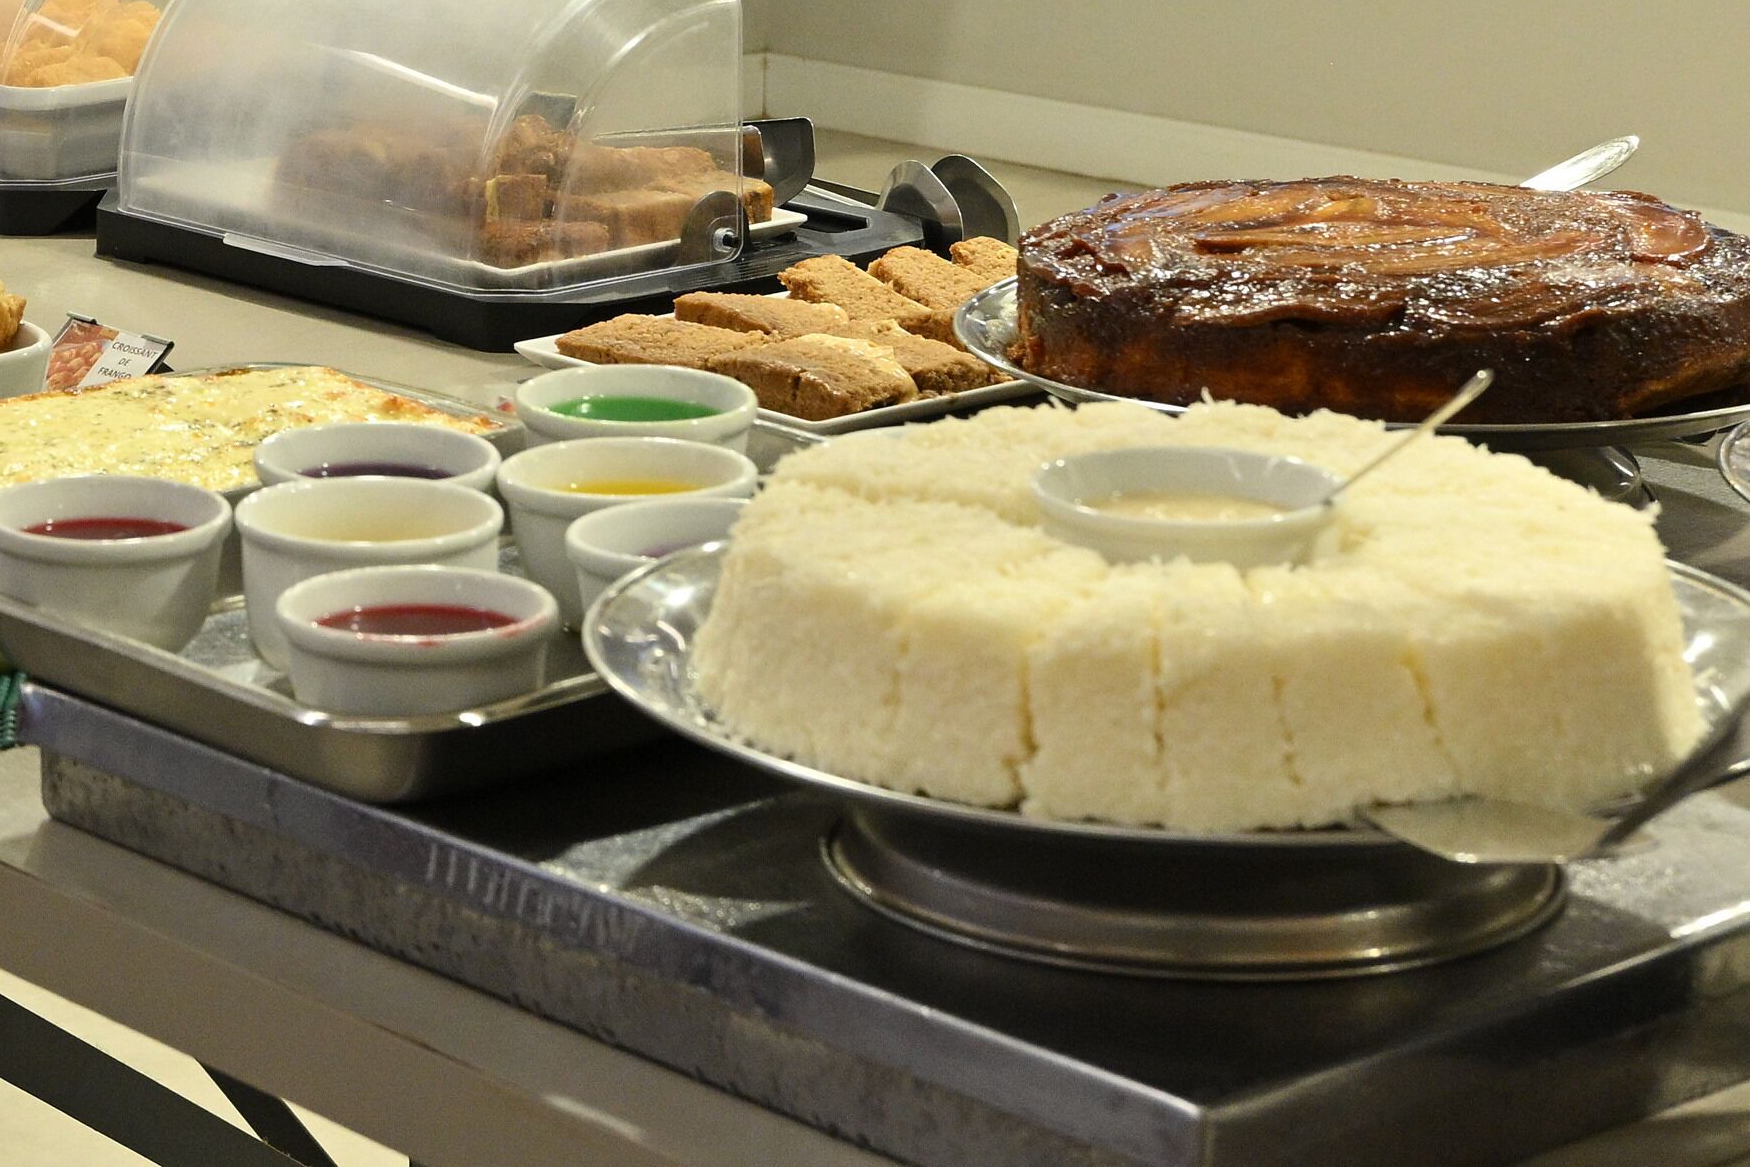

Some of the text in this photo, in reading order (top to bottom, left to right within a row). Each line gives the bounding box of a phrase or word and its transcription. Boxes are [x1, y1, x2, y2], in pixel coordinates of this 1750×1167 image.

[111, 342, 158, 359] CROISSANT
[117, 357, 133, 367] DE
[98, 367, 132, 380] FRANGO
